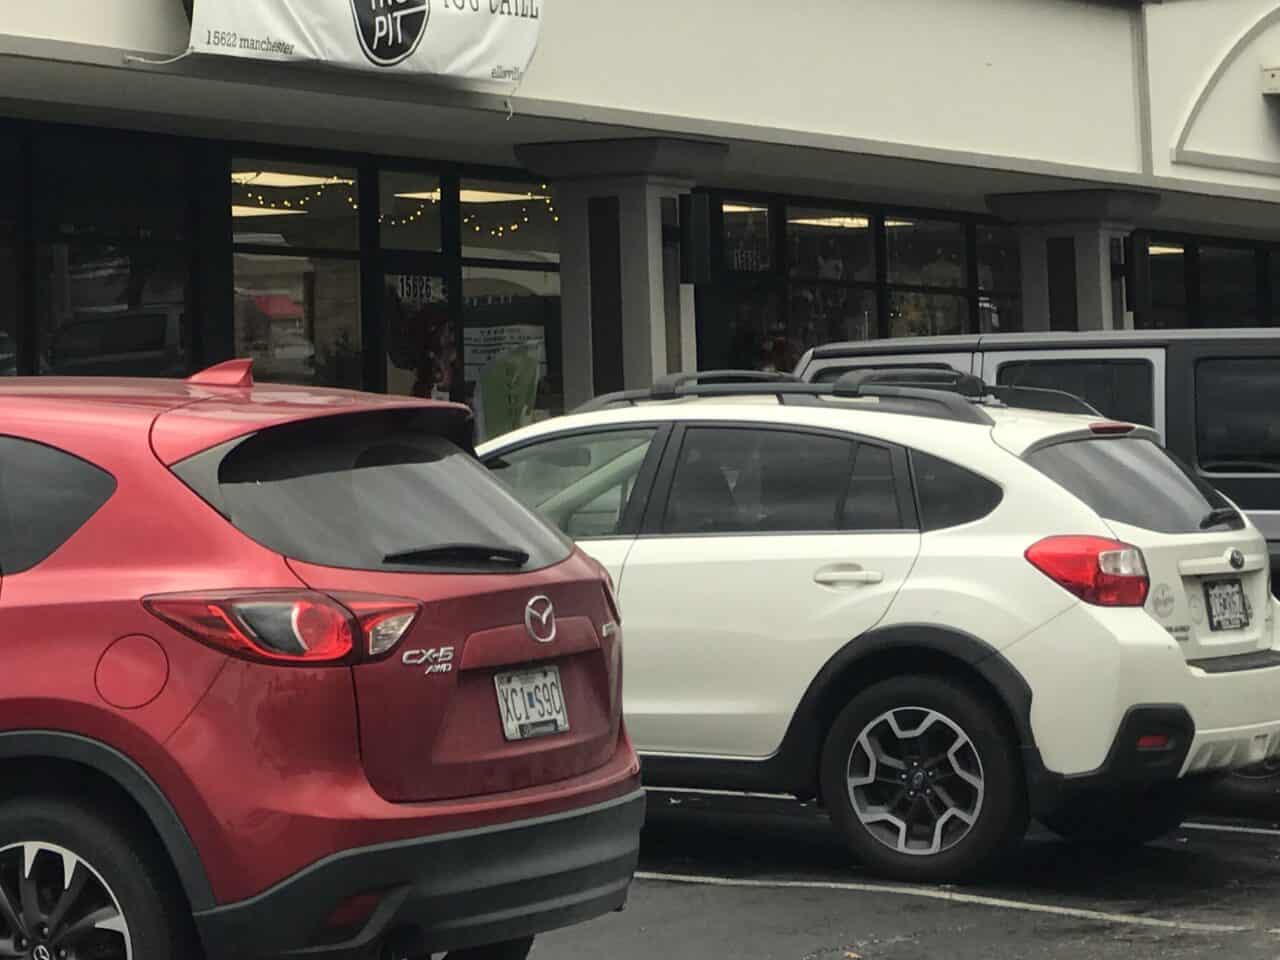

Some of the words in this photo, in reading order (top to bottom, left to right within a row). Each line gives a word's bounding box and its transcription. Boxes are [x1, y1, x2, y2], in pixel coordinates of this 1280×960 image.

[371, 7, 418, 51] PIT
[206, 30, 237, 48] 15622
[239, 36, 295, 56] manchester
[402, 645, 455, 665] CX-5
